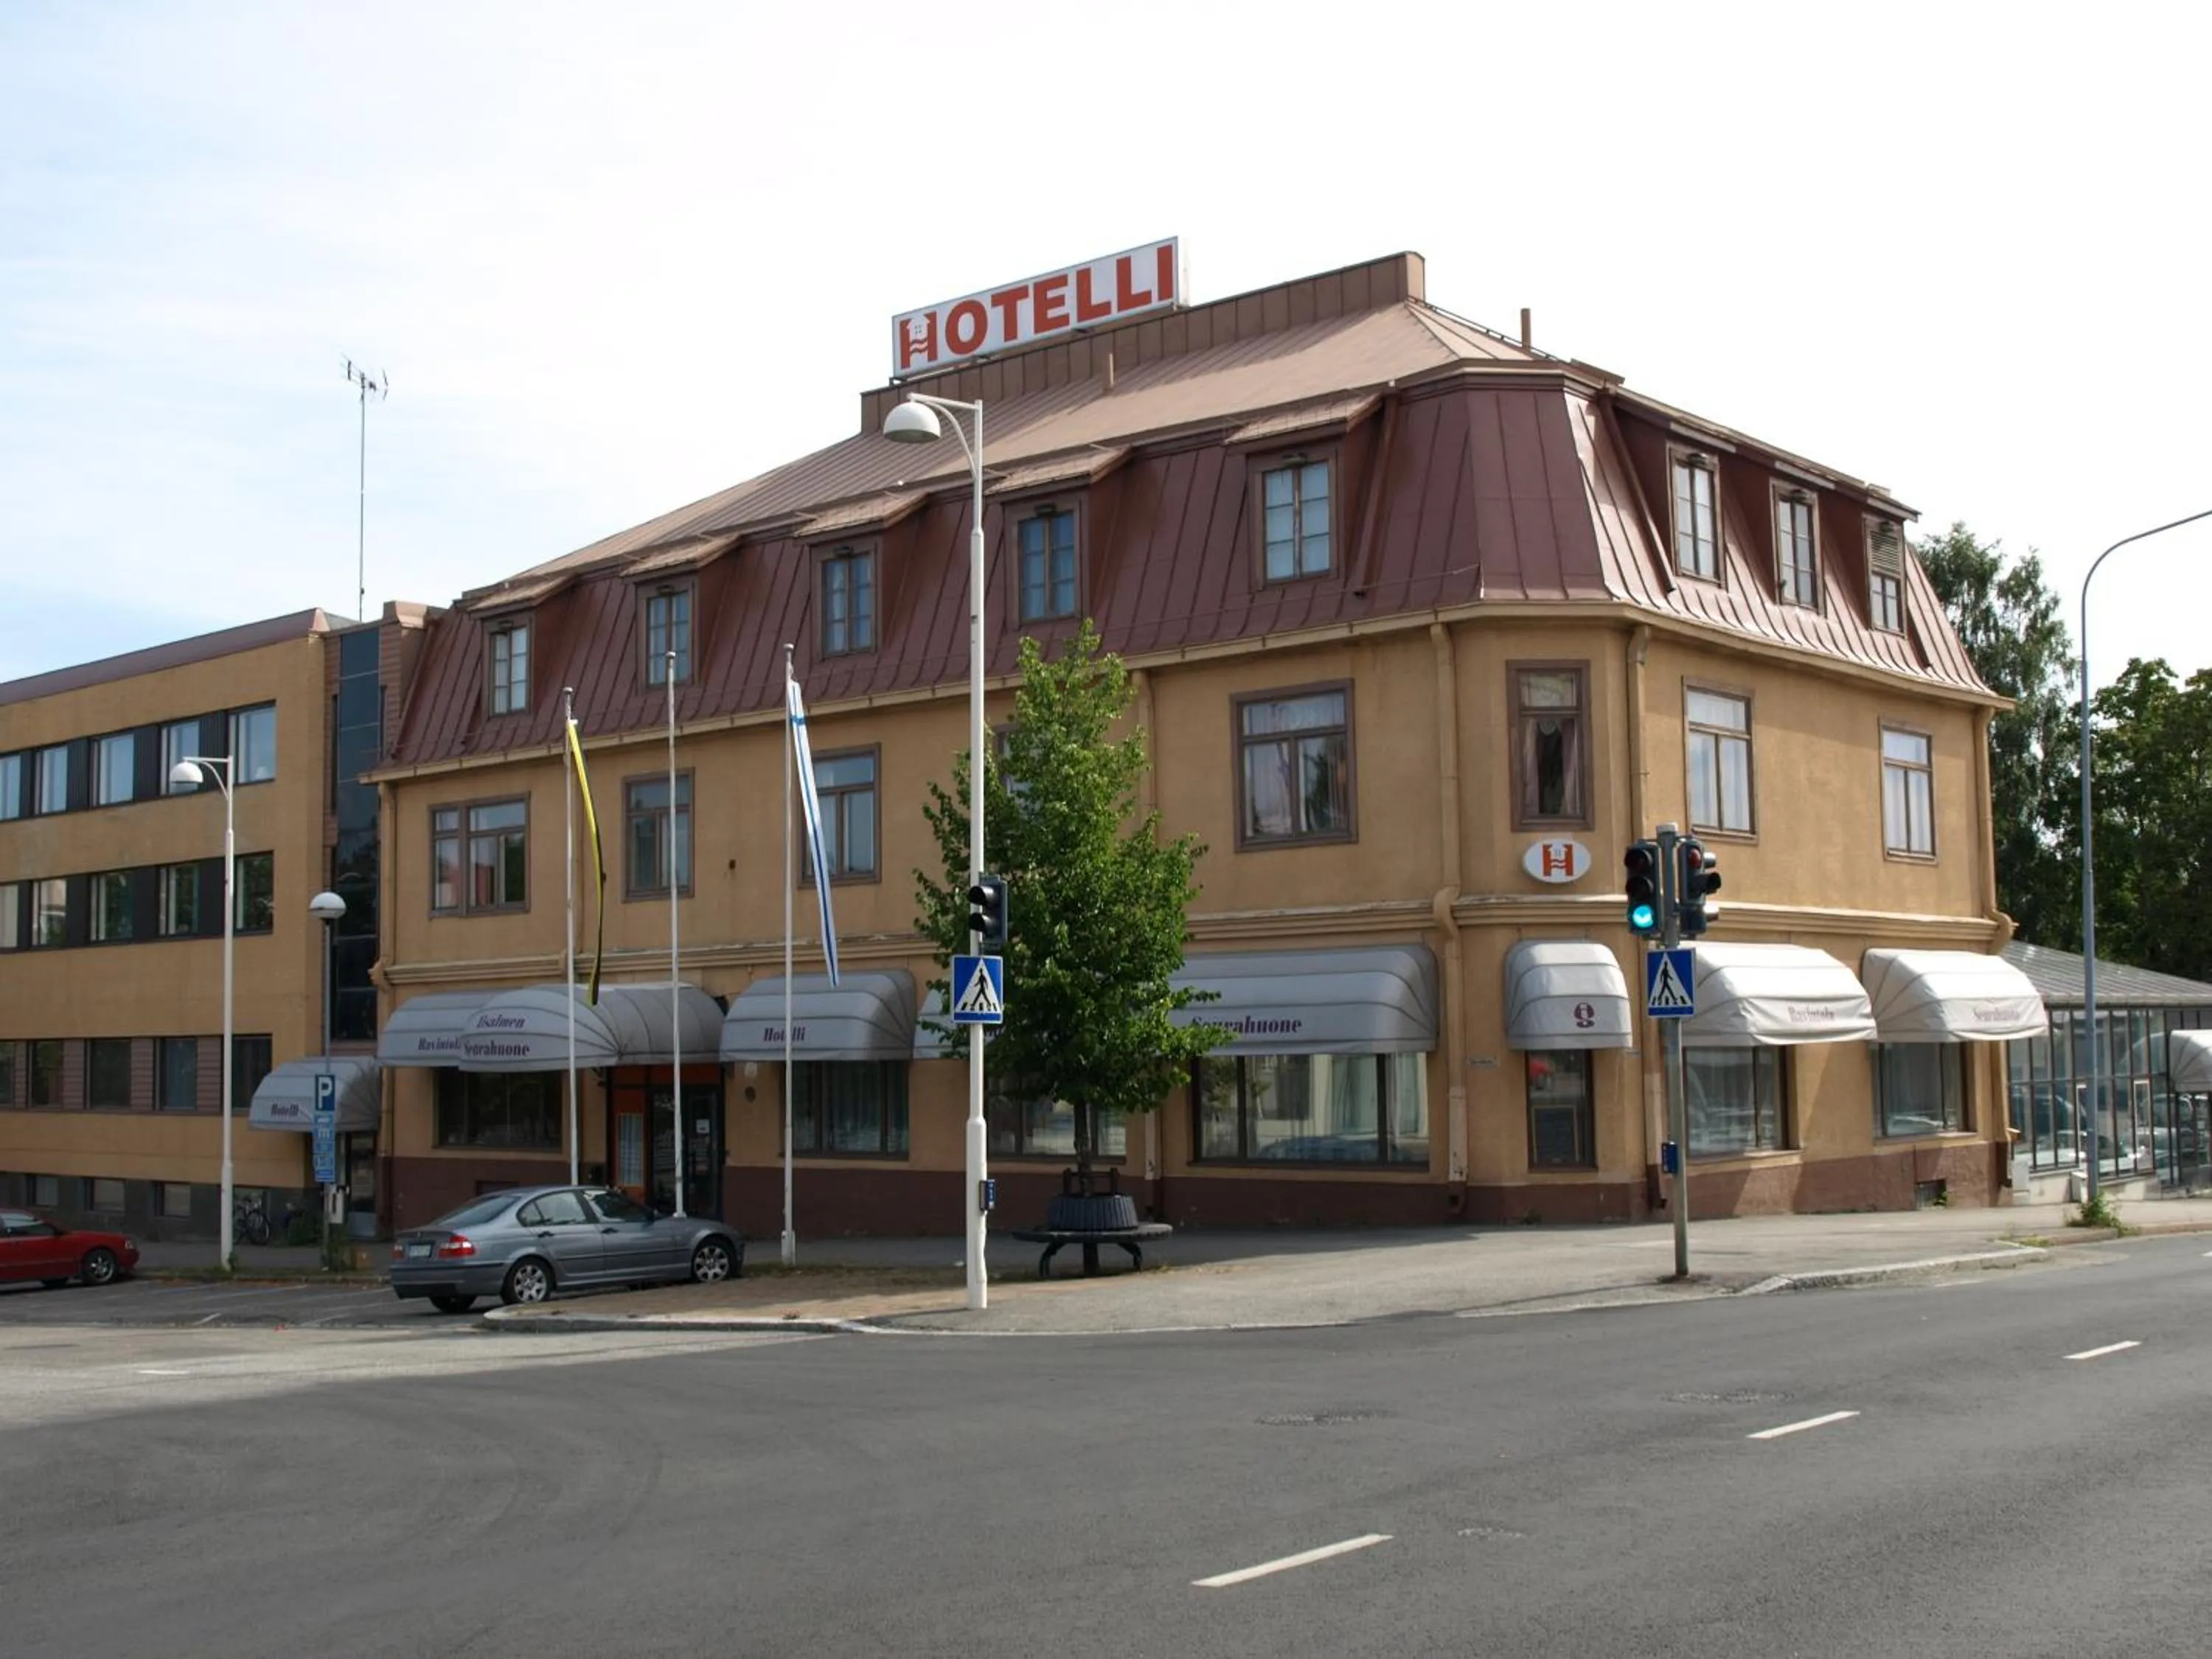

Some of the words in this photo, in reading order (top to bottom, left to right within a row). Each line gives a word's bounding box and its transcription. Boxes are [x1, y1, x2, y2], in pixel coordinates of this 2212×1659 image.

[899, 244, 1174, 369] HOTELLI
[418, 1037, 461, 1051] Ravintol
[763, 1026, 807, 1042] Hotlli
[318, 1076, 333, 1109] P
